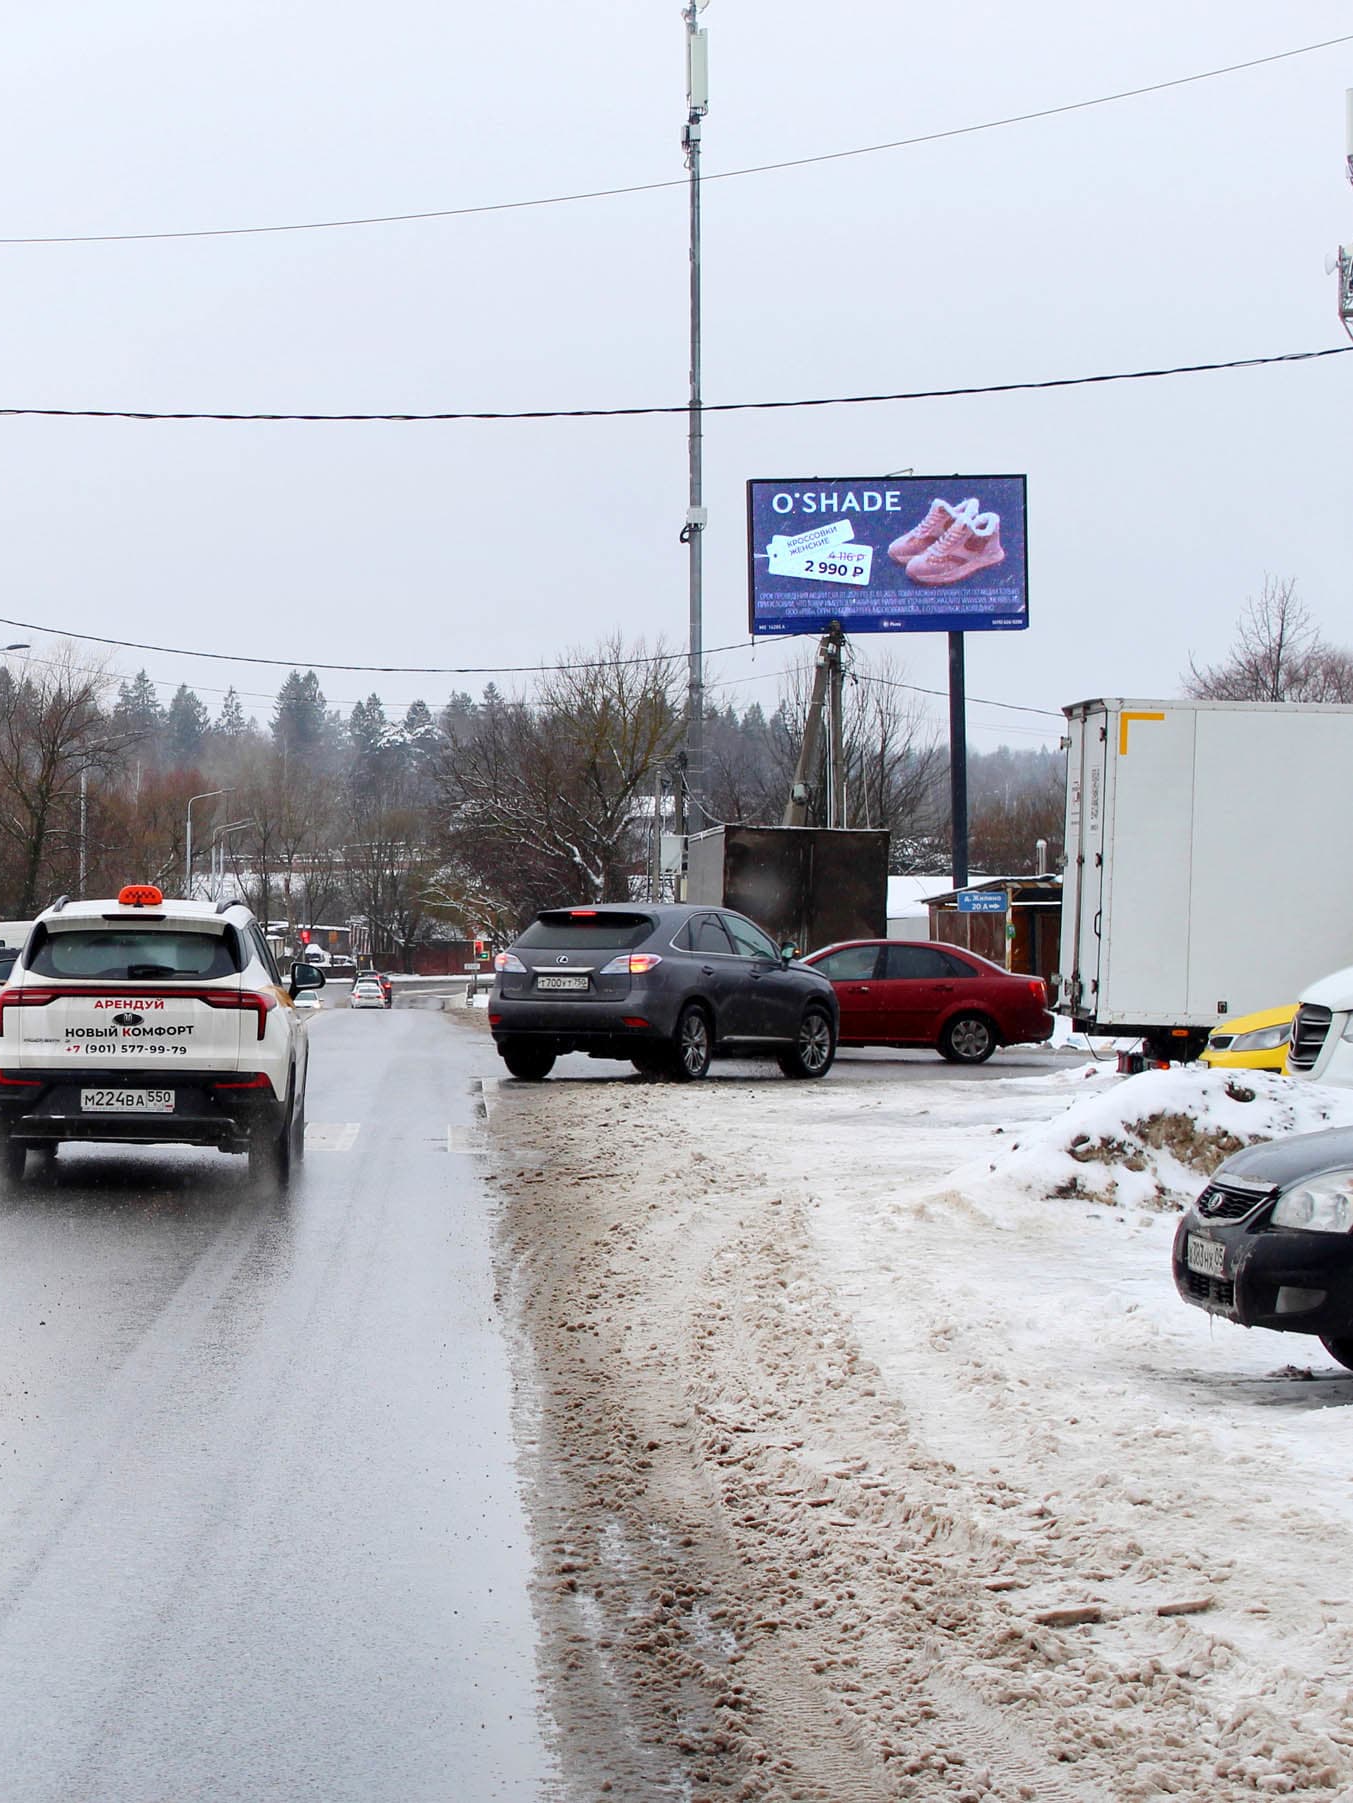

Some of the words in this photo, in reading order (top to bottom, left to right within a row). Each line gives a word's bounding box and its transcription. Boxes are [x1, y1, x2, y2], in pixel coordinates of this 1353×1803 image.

[786, 526, 837, 548] КРОССОВКИ
[790, 537, 830, 556] ЖЕНСКИЕ
[804, 560, 814, 572] 2
[818, 562, 847, 576] 990
[94, 998, 165, 1011] АРЕНДУЙ
[65, 1025, 118, 1038] НОВЫЙ
[122, 1025, 194, 1037] КОМФОРТ
[65, 1045, 81, 1053] +7
[85, 1043, 116, 1054] (901)
[121, 1044, 187, 1054] 577-99-79
